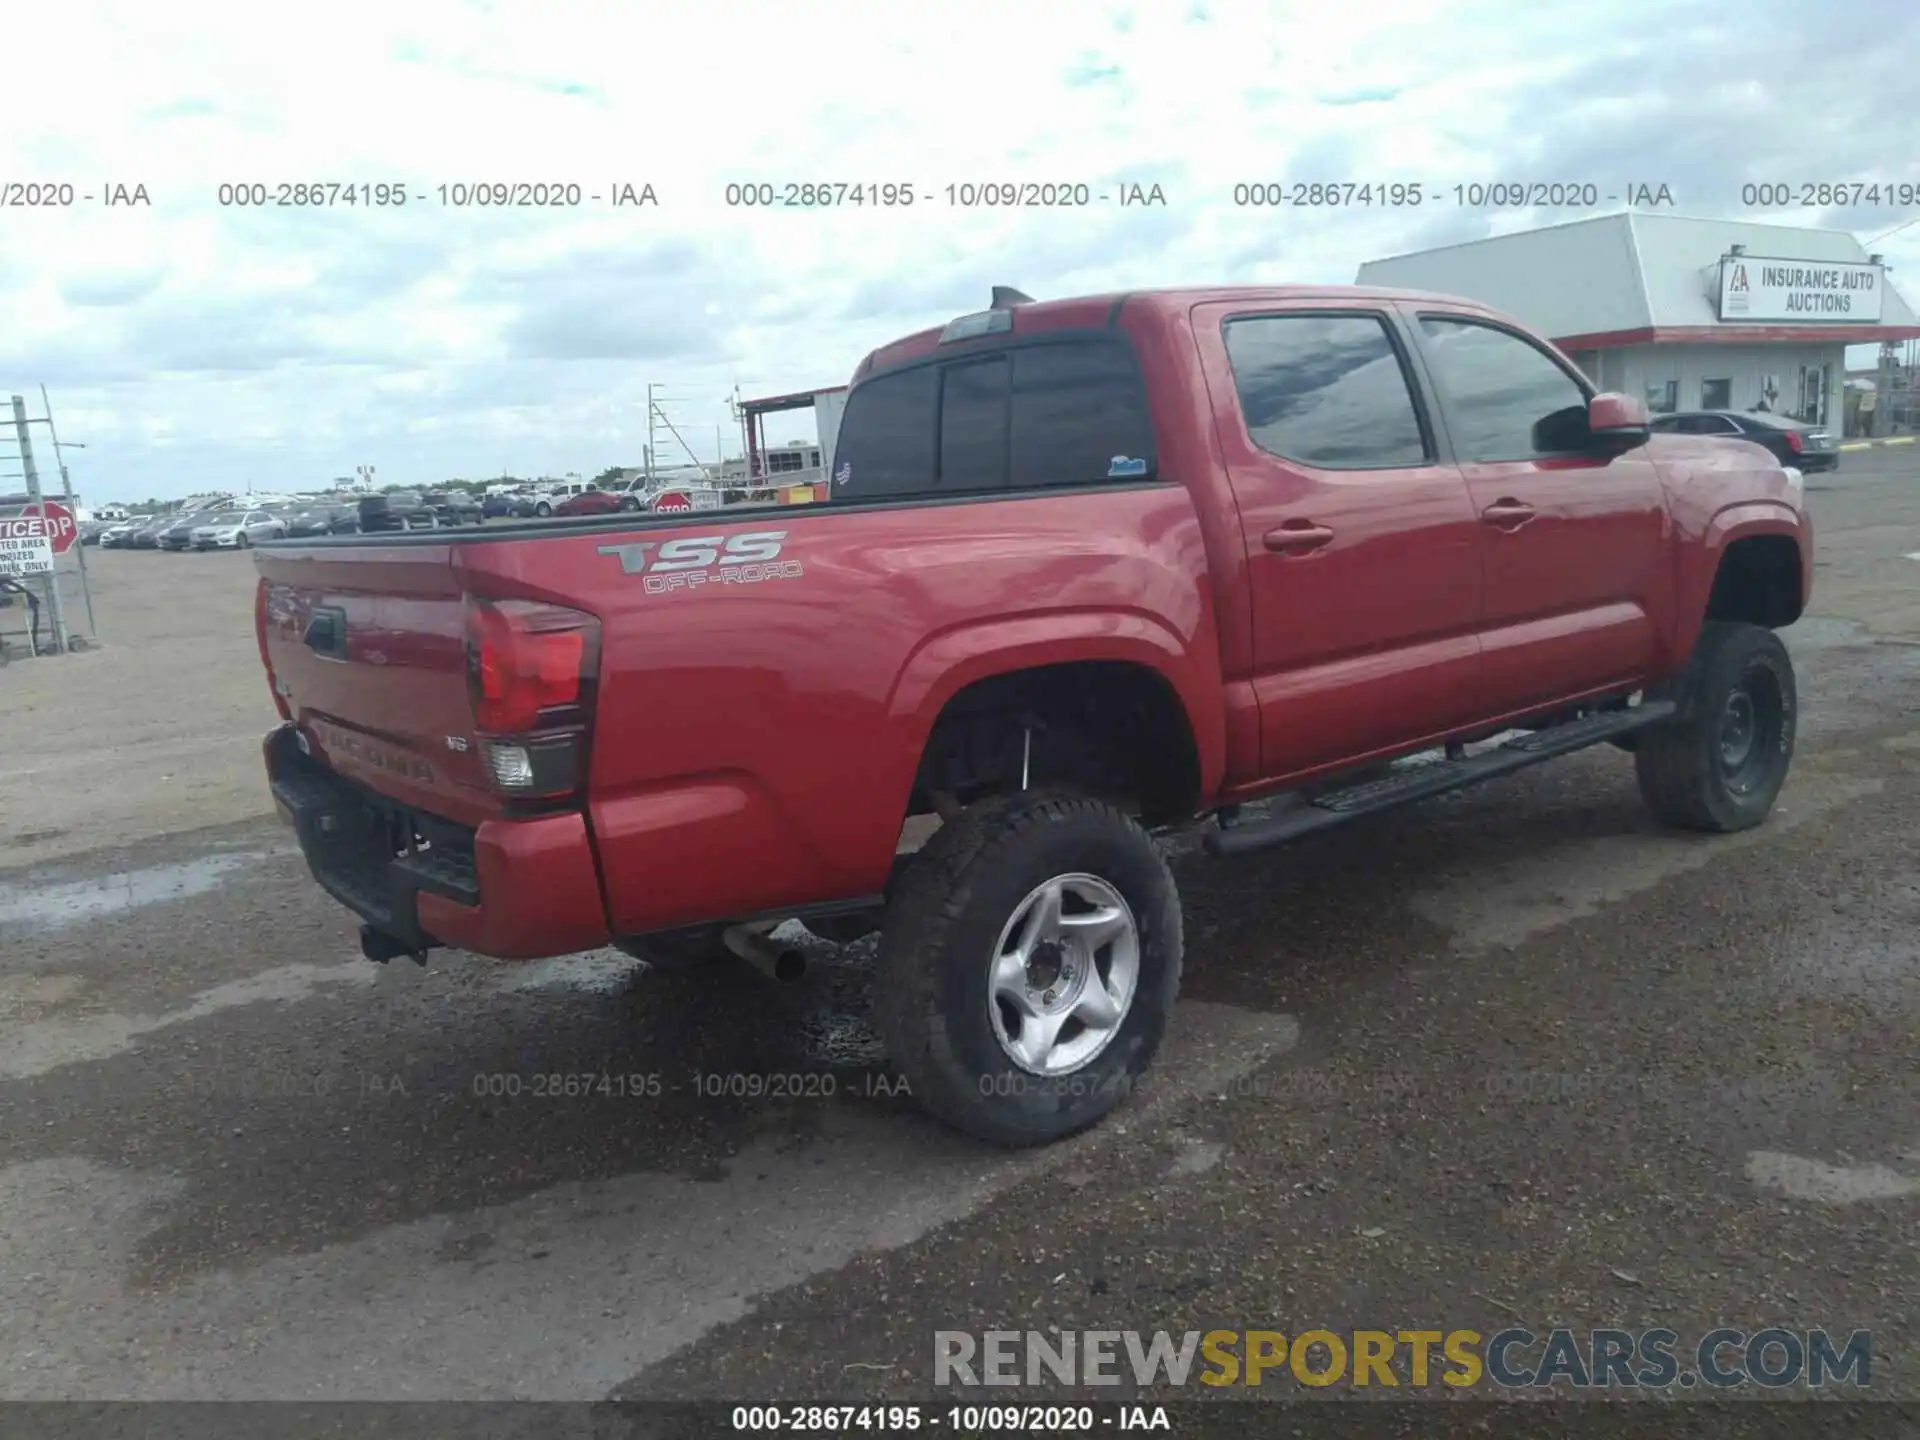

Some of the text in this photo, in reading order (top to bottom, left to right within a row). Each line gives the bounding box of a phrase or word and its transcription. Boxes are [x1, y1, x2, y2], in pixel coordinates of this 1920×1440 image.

[1762, 266, 1874, 291] INSURANCE AUTO
[1786, 293, 1851, 312] AUCTIONS
[21, 539, 45, 549] AREA
[597, 531, 788, 574] TSS
[643, 560, 804, 594] OFF-ROAD
